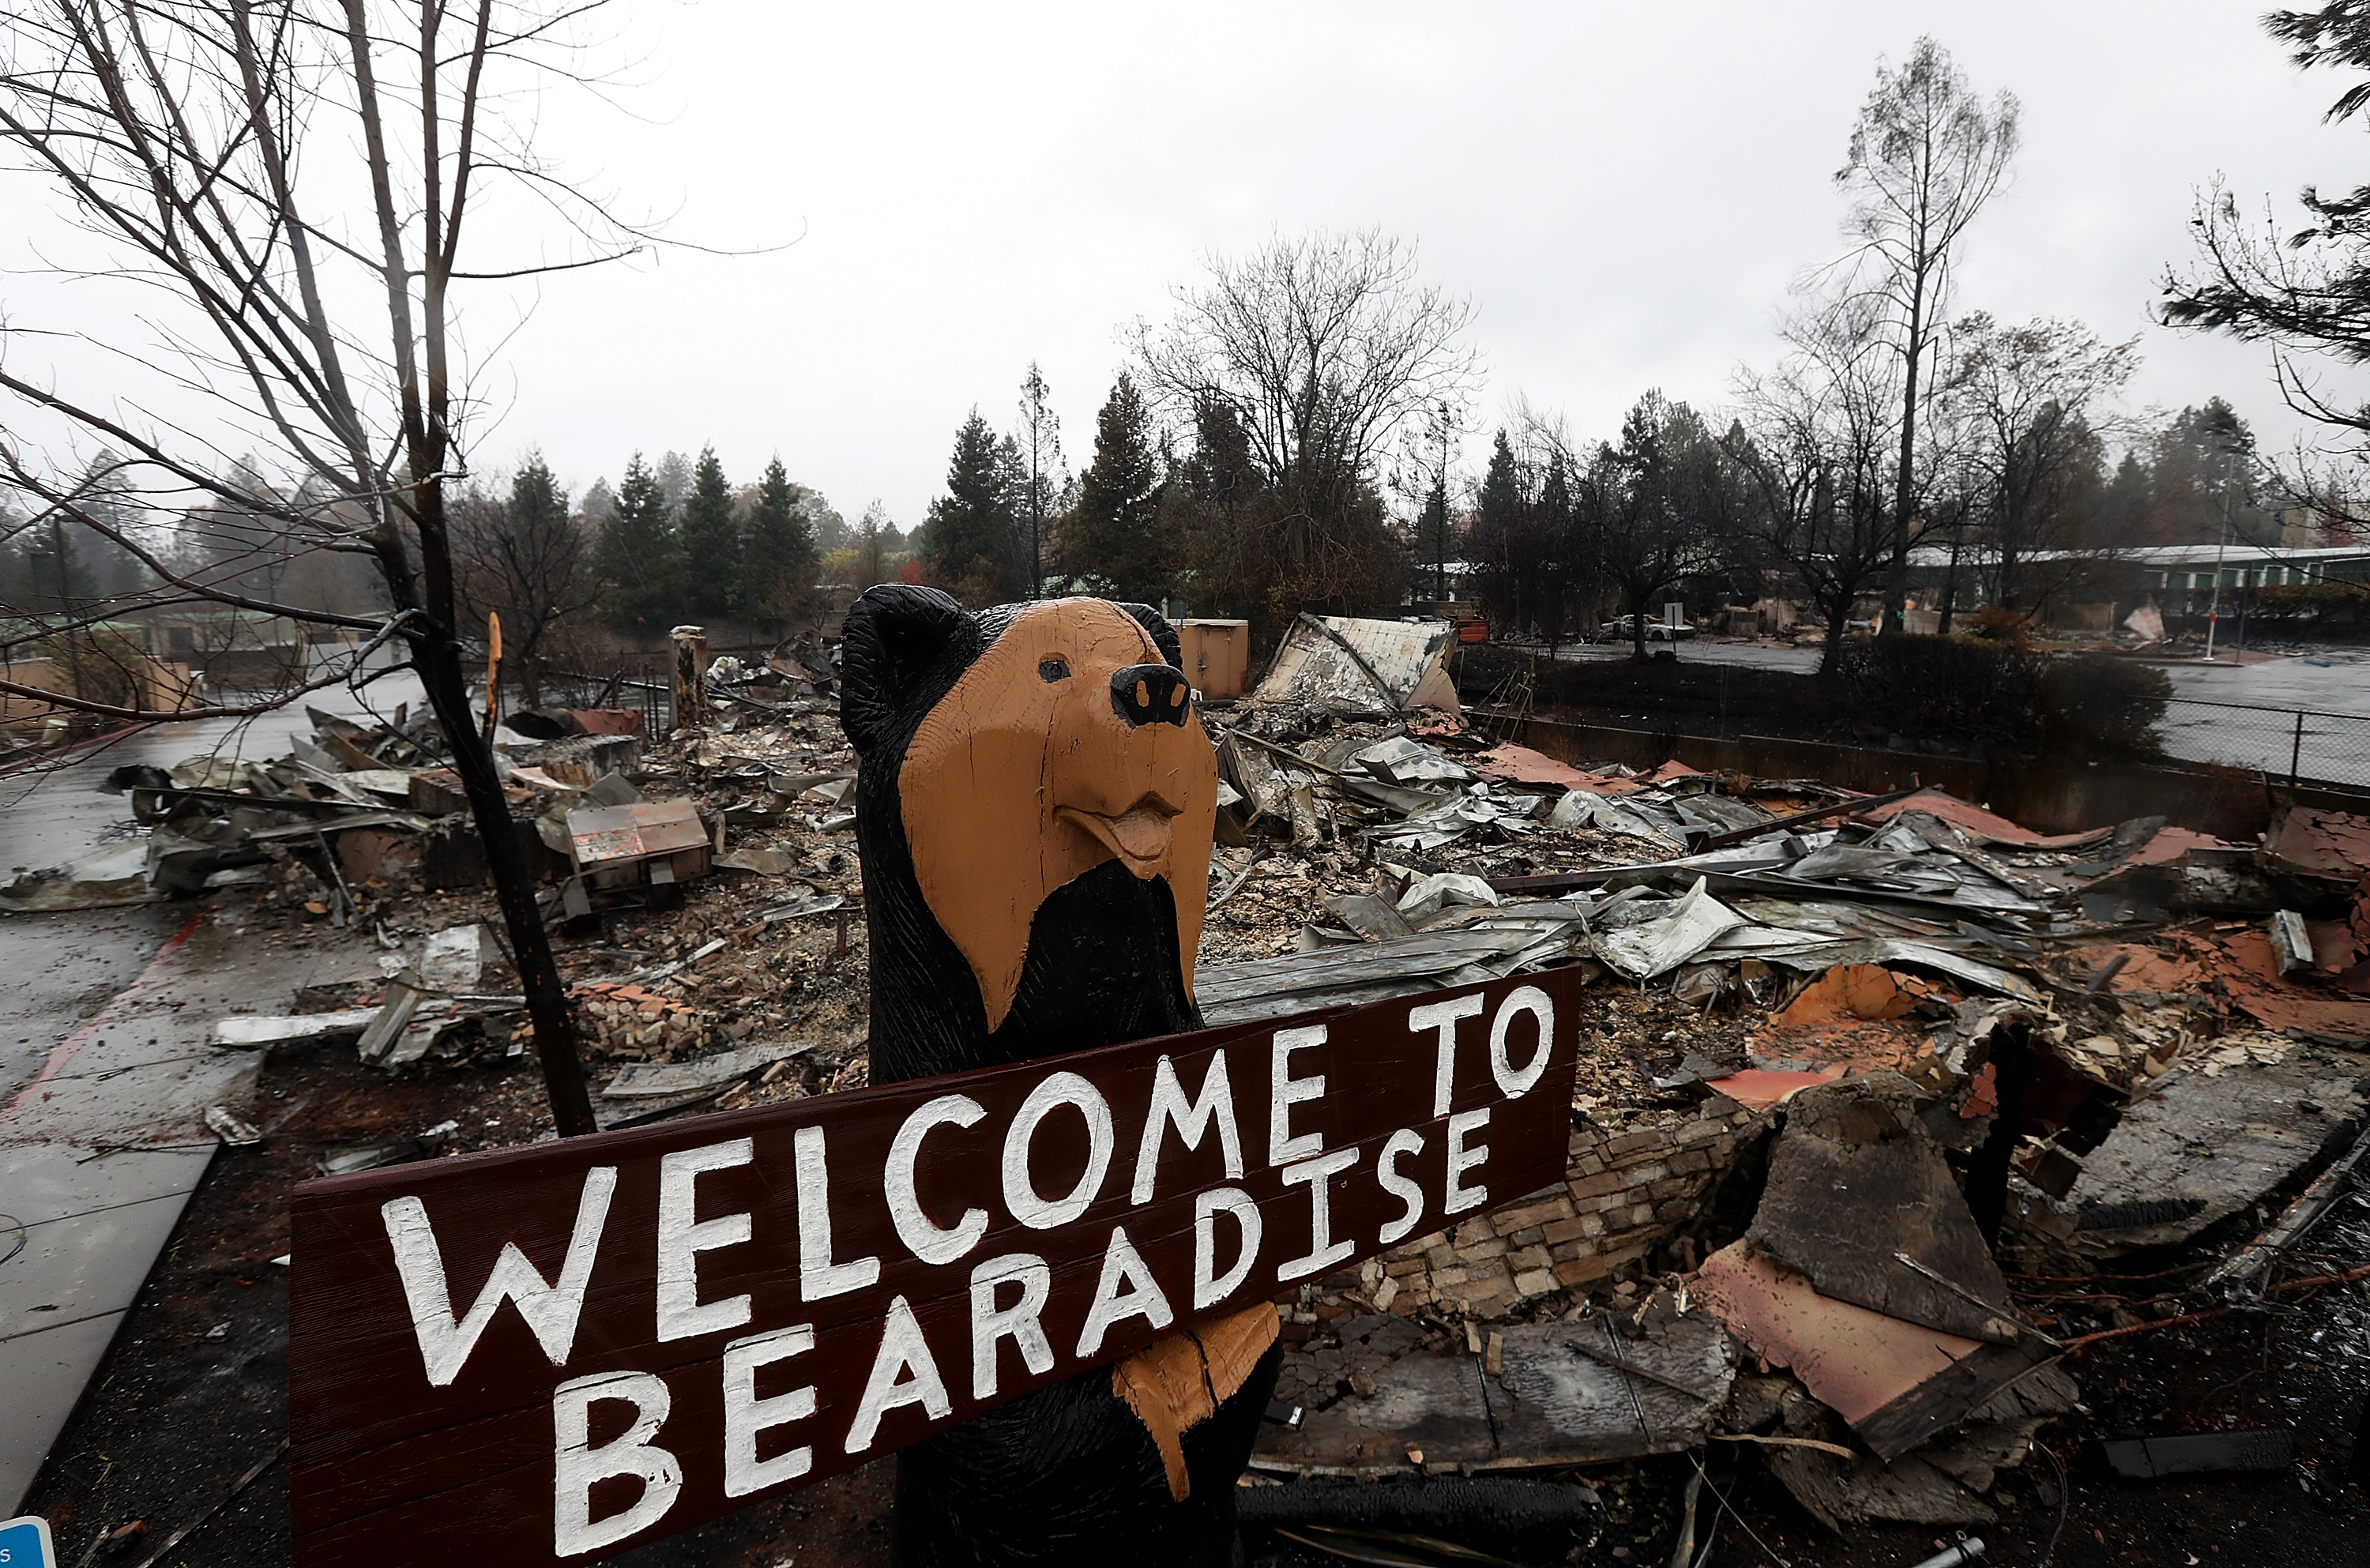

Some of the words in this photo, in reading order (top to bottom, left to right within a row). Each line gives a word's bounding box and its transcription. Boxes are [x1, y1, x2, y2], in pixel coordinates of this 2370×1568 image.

[381, 1024, 1328, 1386] WELCOME
[1409, 984, 1555, 1119] TO
[554, 1107, 1491, 1558] BEARADISE
